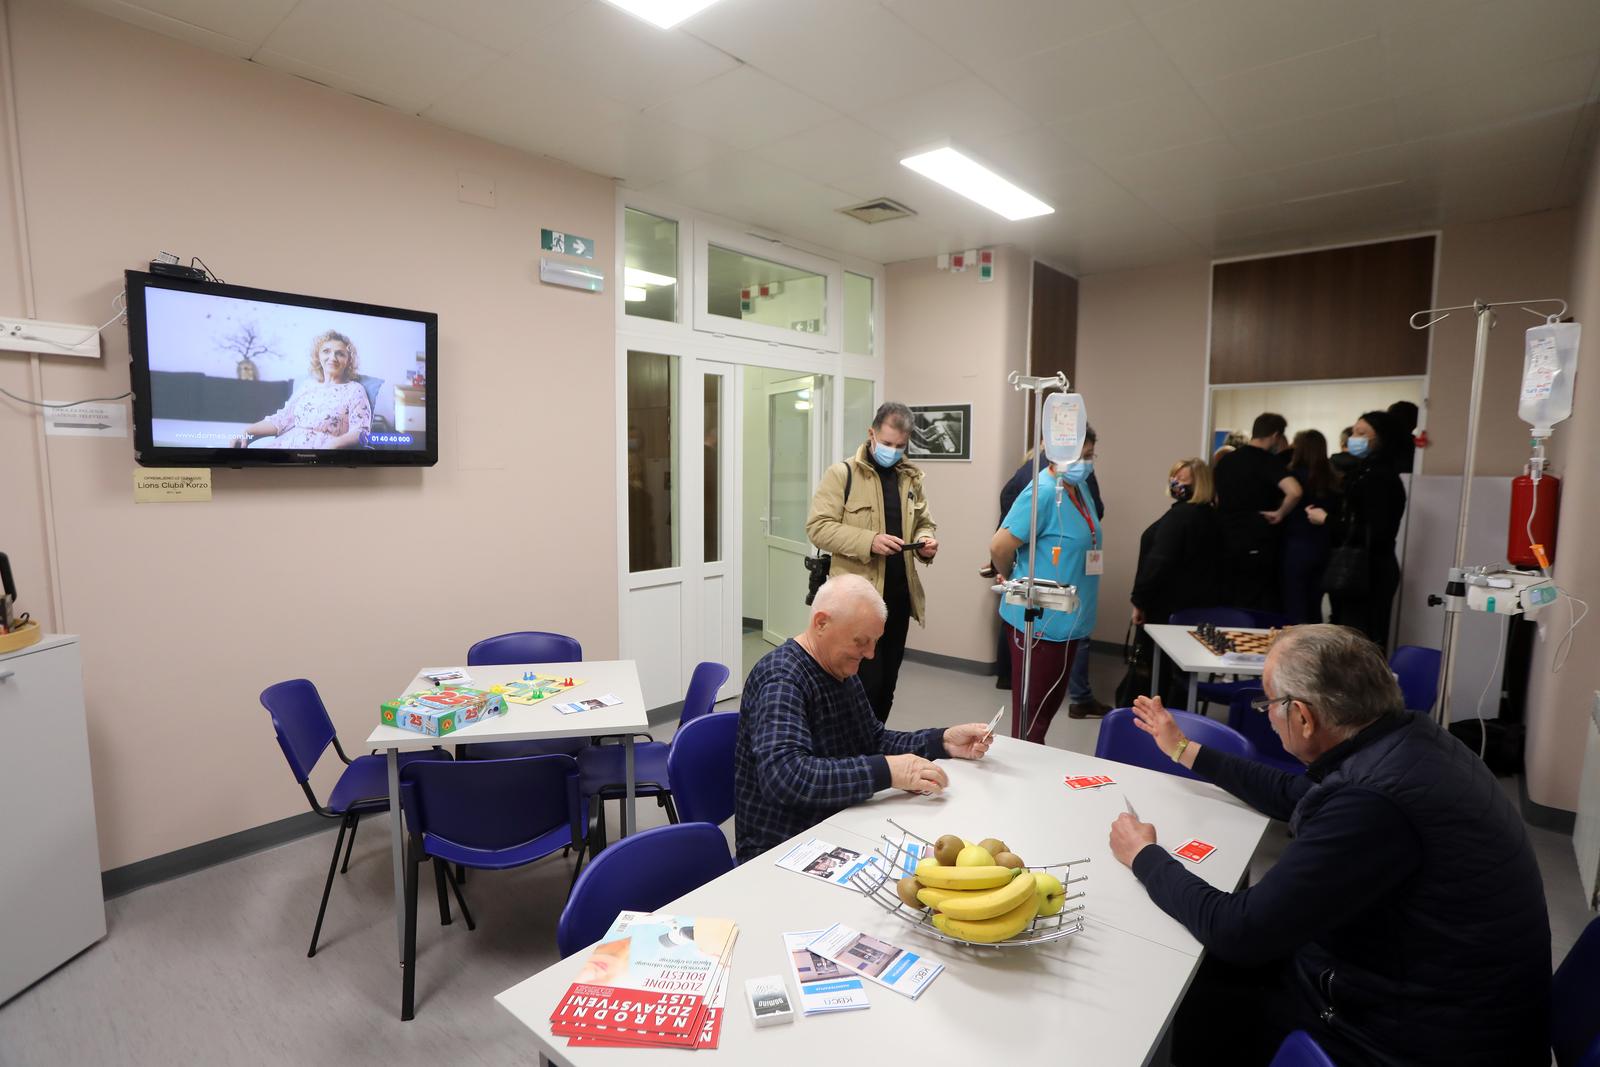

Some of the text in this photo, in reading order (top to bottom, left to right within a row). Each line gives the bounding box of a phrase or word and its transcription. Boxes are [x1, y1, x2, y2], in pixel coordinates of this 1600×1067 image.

[137, 481, 160, 489] Lions
[409, 713, 423, 728] 25
[660, 970, 706, 981] BOLESTI
[568, 996, 693, 1016] ZDRAVSTVENI
[660, 994, 697, 1005] LIST
[559, 1005, 688, 1028] NARODNI
